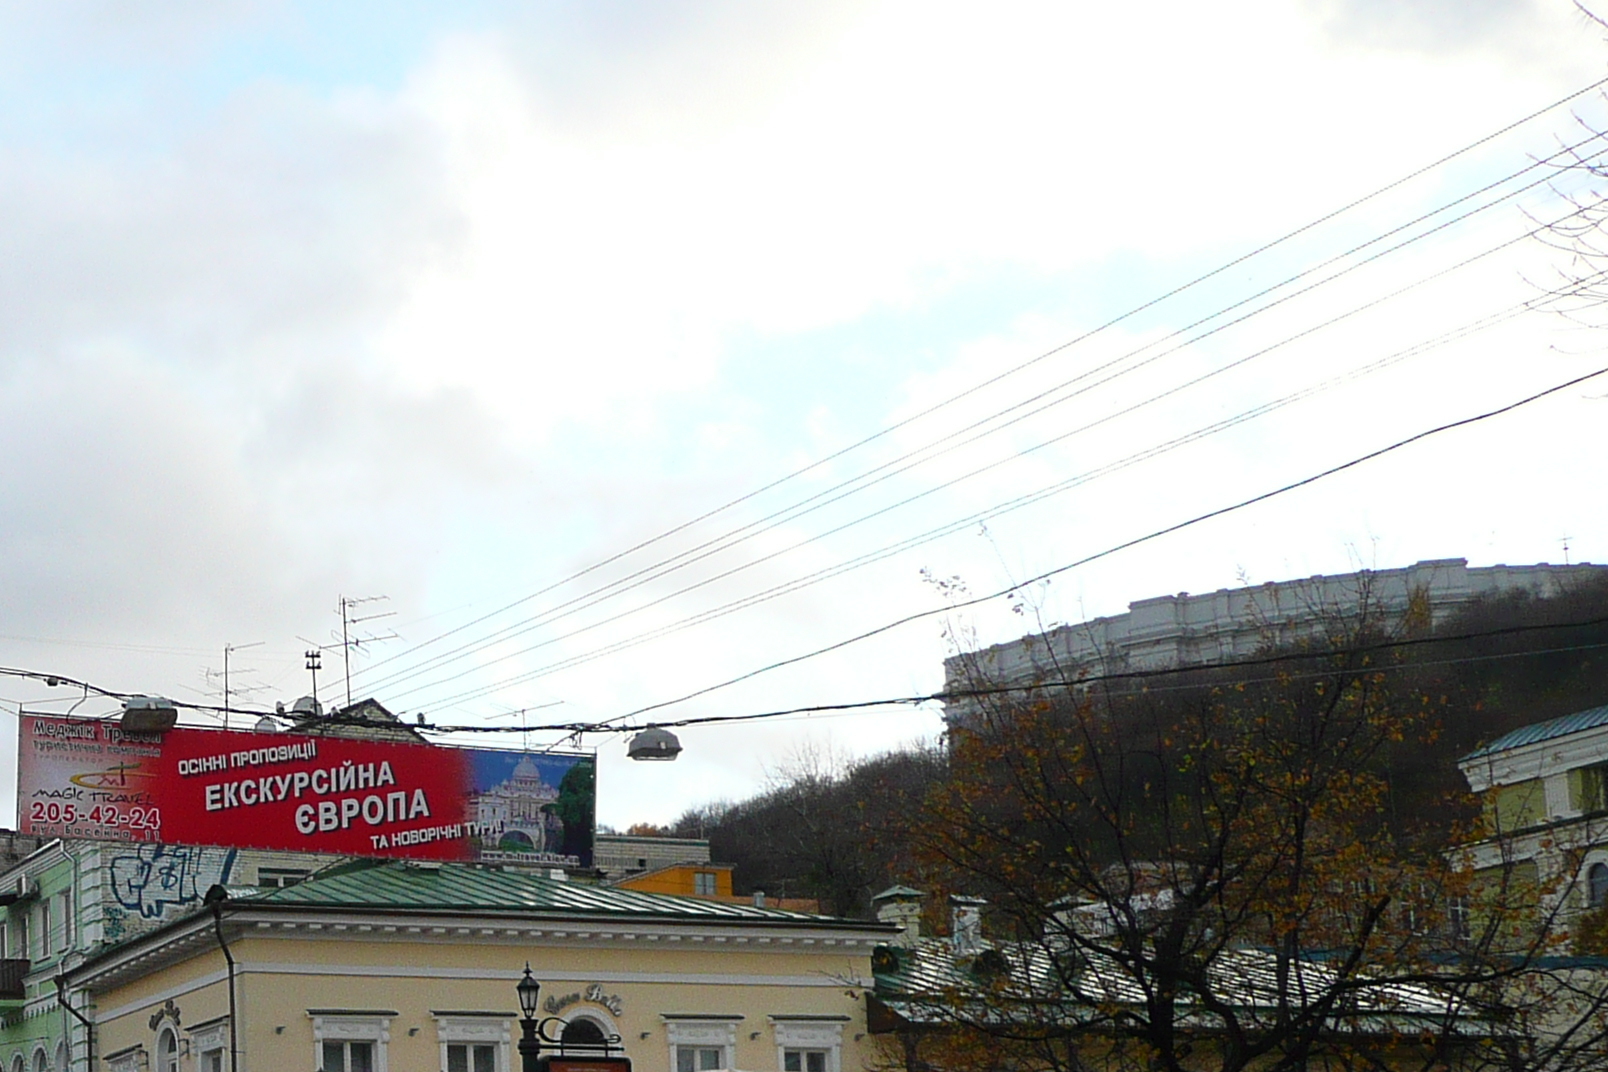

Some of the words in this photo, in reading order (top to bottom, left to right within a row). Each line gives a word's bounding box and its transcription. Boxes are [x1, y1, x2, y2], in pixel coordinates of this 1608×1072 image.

[33, 719, 95, 739] Меджік
[178, 754, 227, 775] ОСІННІ
[230, 739, 317, 768] ПРОПОЗИЦІЇ
[32, 787, 85, 800] MAGIC
[89, 792, 155, 805] TRAVEL
[205, 760, 396, 811] ЕКСКУРСІЙНА
[30, 802, 161, 829] 205-42-24
[295, 788, 430, 834] ЄВРОПА
[370, 834, 389, 850] ТА
[392, 823, 462, 846] НОВОРІЧНІ
